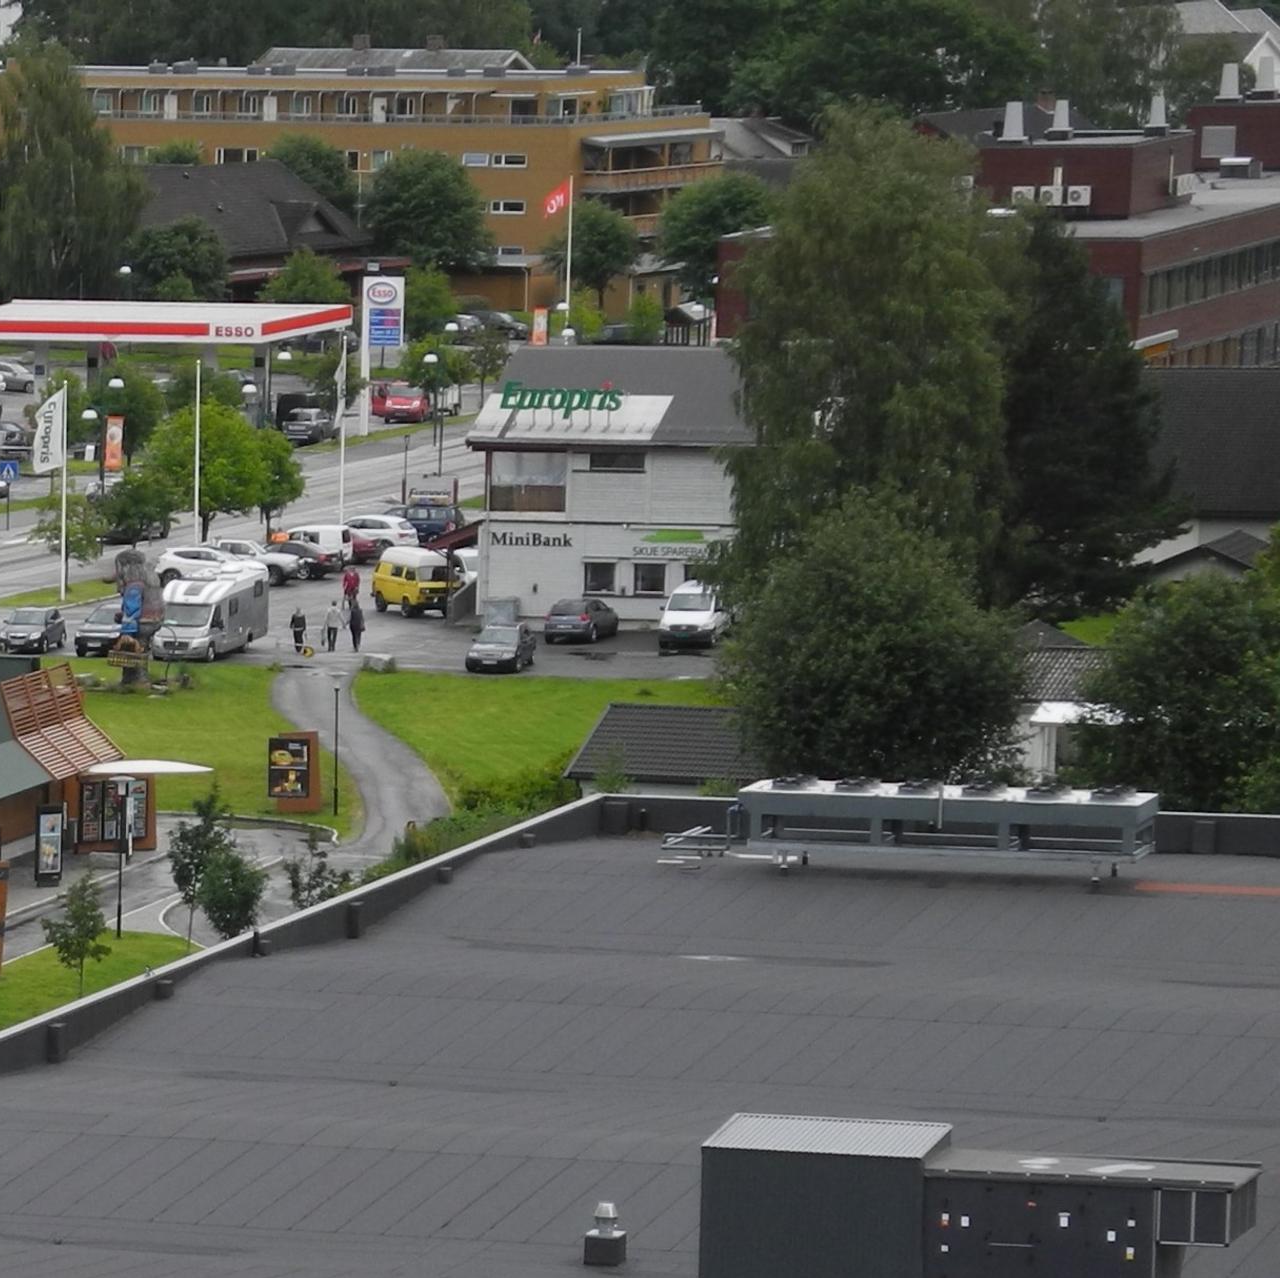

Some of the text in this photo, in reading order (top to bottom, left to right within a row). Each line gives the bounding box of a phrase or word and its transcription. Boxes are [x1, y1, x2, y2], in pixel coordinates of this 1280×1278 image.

[371, 287, 394, 298] Esso
[215, 325, 255, 338] ESSO
[500, 380, 624, 420] Europris
[491, 531, 573, 547] MiniBank
[632, 546, 659, 556] SKUE
